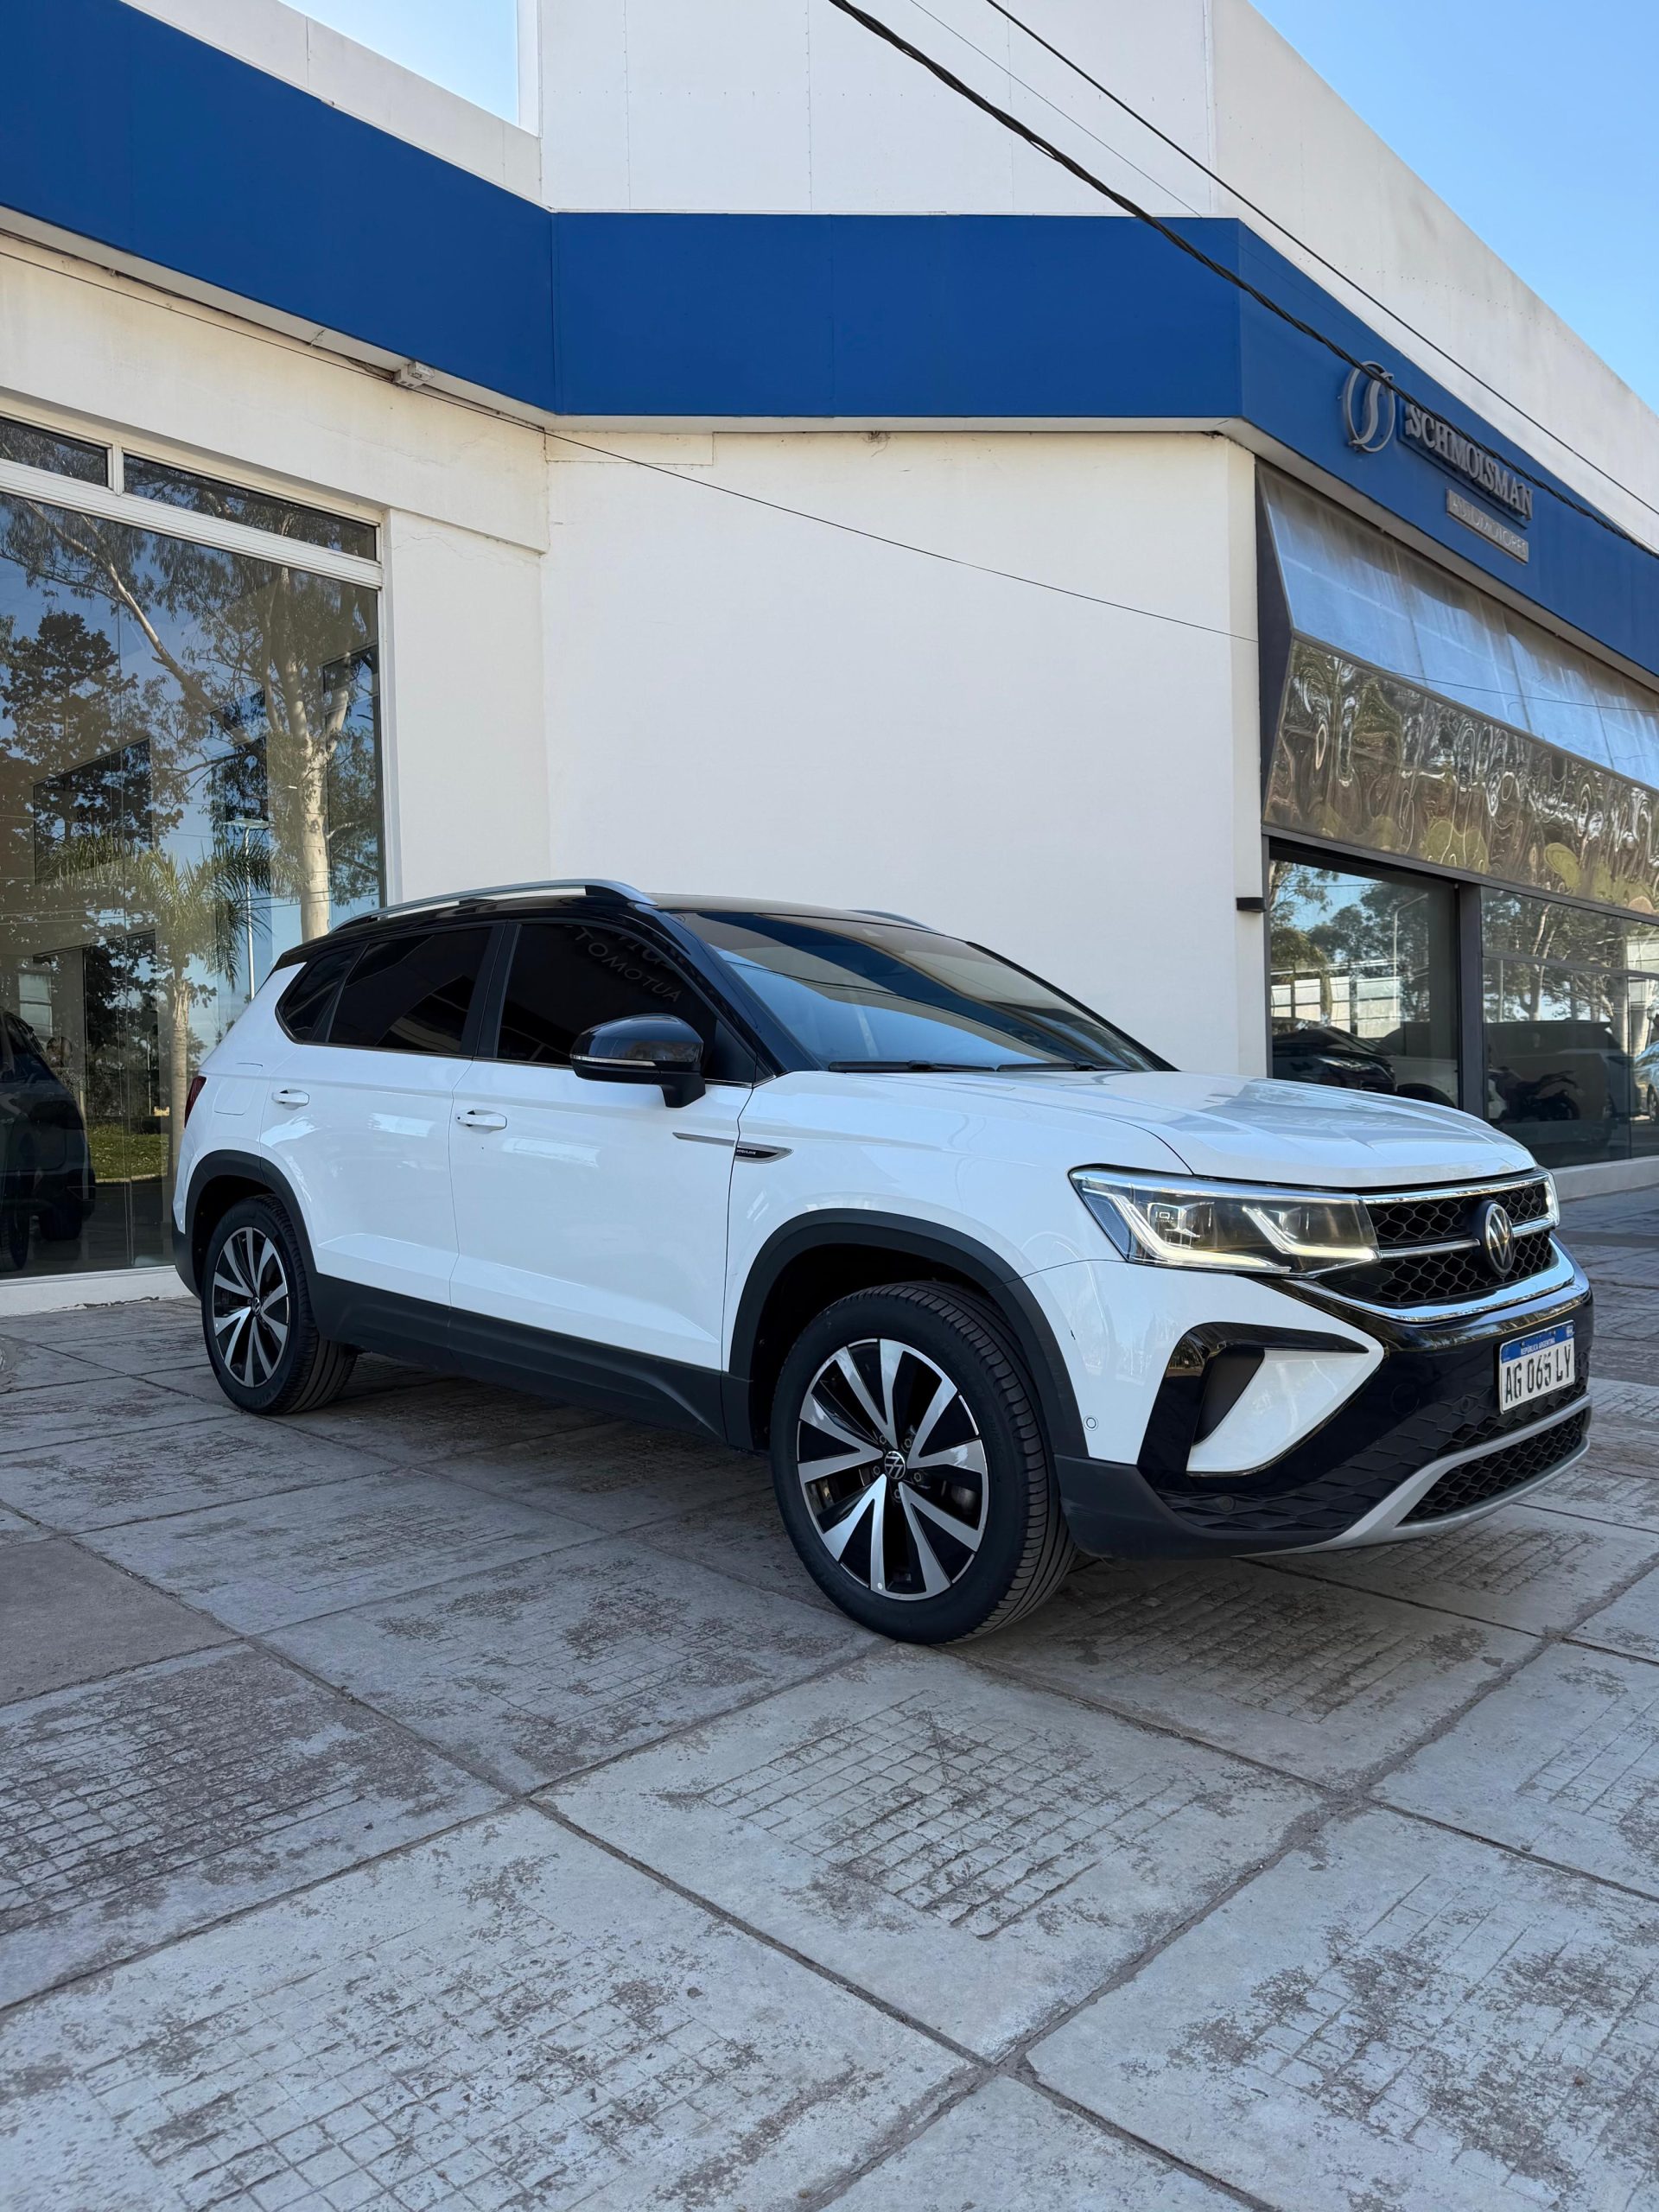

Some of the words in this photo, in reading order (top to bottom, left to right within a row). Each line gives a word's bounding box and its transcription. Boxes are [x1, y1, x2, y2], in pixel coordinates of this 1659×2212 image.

[1406, 404, 1533, 520] SCHMOISMAN
[1505, 1362, 1522, 1403] AG
[1527, 1352, 1552, 1394] 065
[1556, 1344, 1571, 1382] LY
